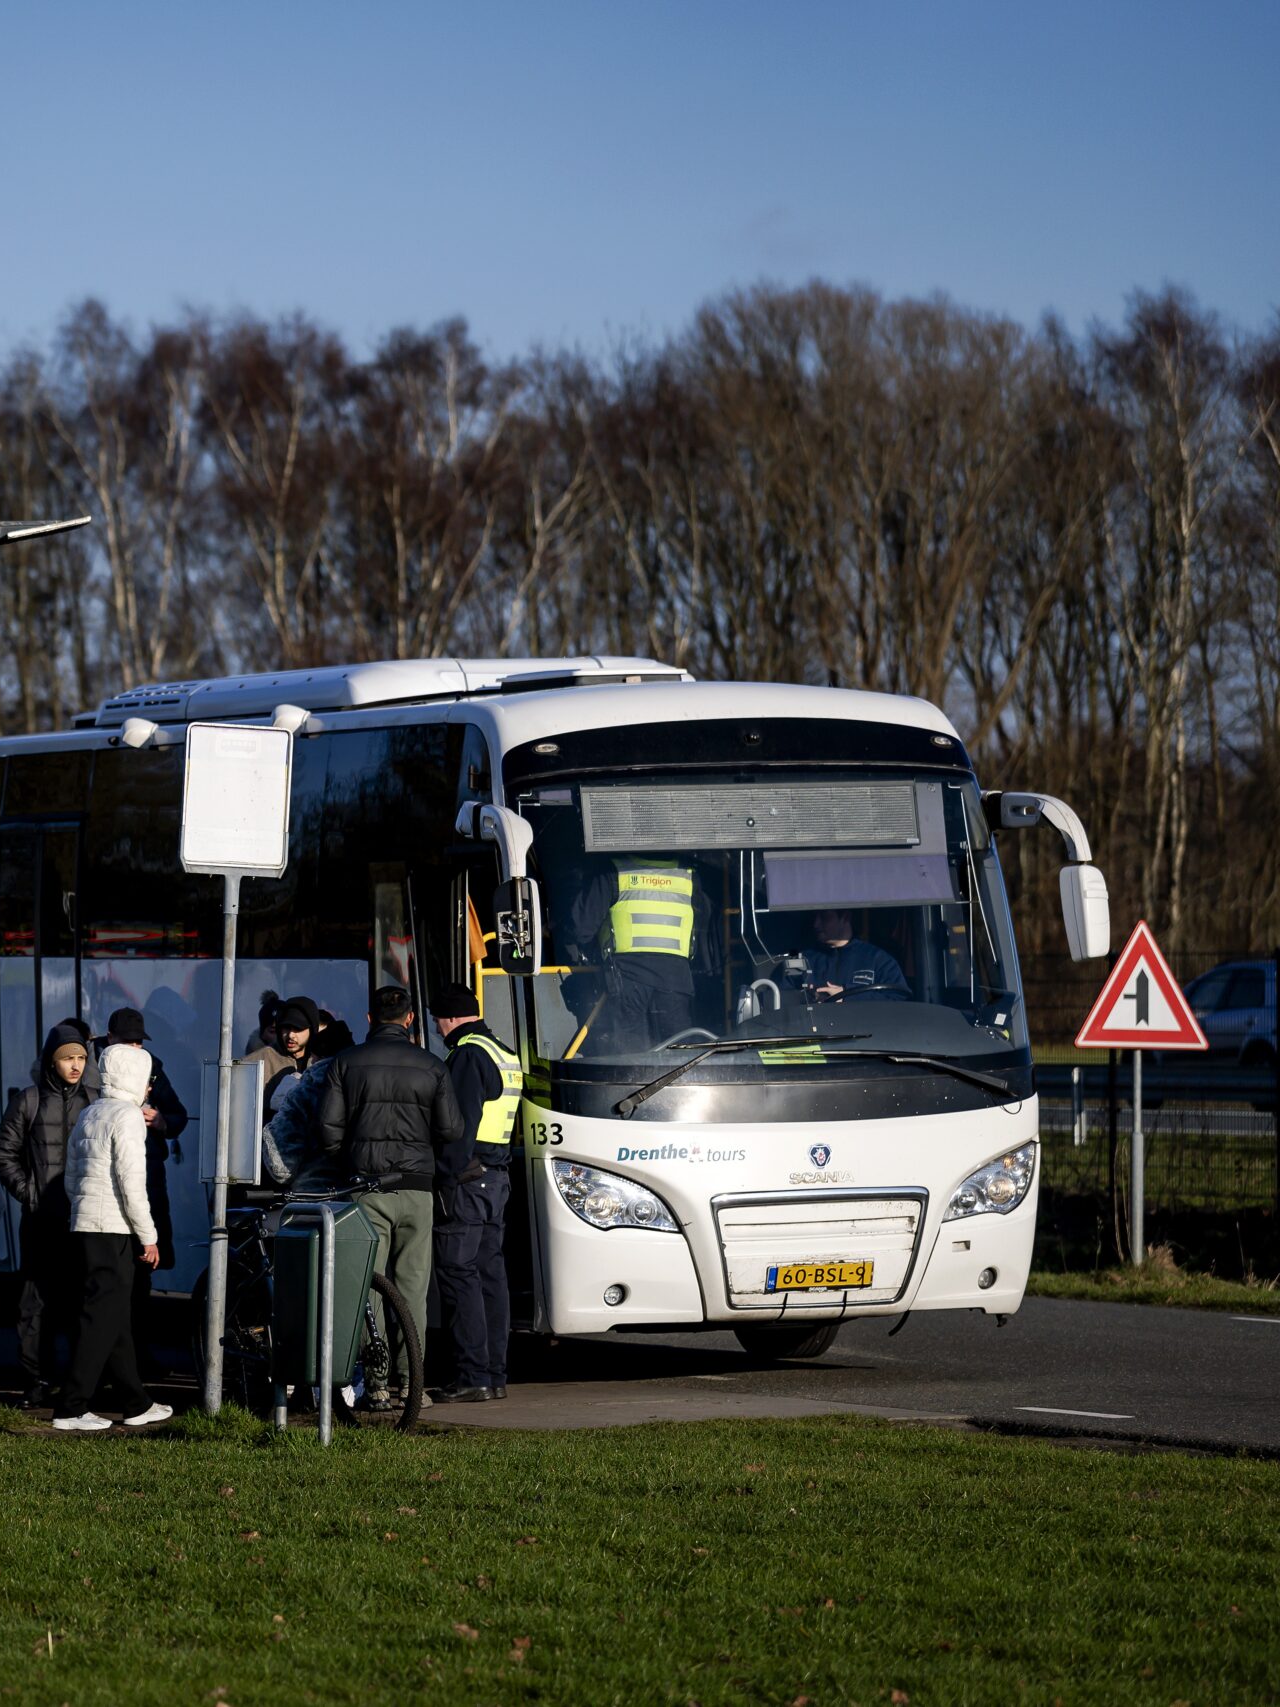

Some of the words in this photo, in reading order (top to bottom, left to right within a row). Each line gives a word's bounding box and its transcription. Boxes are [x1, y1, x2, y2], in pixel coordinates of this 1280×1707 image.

[640, 875, 672, 887] Trigion
[530, 1122, 564, 1146] 133
[616, 1143, 689, 1162] Drenthe
[706, 1147, 747, 1162] tours
[789, 1170, 856, 1185] SCANIA
[782, 1266, 866, 1285] 60-BSL-9
